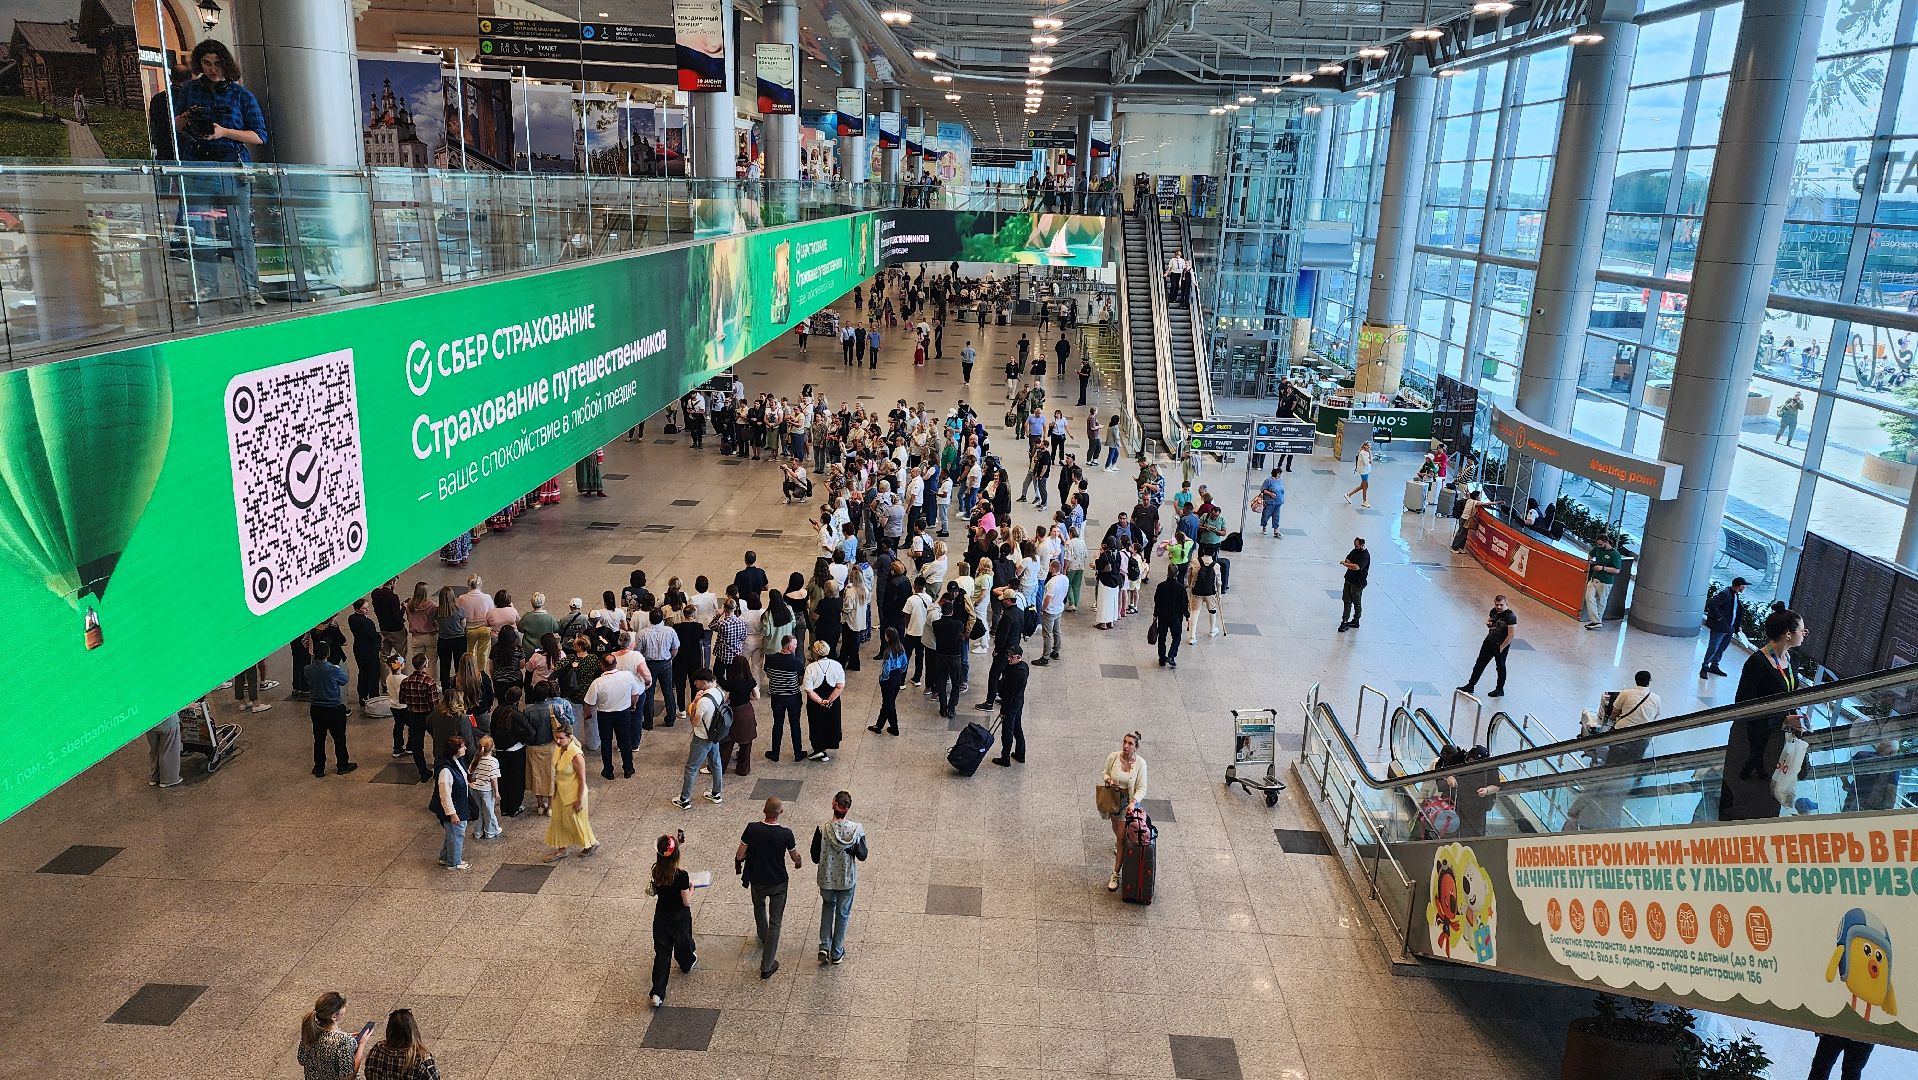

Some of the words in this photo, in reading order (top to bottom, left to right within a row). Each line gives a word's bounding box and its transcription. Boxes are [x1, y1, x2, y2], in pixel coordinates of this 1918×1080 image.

[437, 333, 489, 377] СБЕР
[491, 304, 596, 361] СТРАХОВАНИЕ
[412, 377, 549, 460] Страхование
[552, 329, 667, 403] путешественников
[438, 461, 478, 501] ваше
[481, 420, 561, 477] спокойствие
[562, 418, 570, 434] в
[571, 392, 603, 429] любой
[1588, 458, 1627, 482] Meeting
[1628, 471, 1658, 488] point
[60, 704, 140, 757] sberbankins.ru
[1515, 844, 1576, 868] ЛЮБИМЫЕ
[1577, 843, 1623, 866] ГЕРОИ
[1625, 835, 1769, 866] МИ-МИ-МИШЕК
[1770, 831, 1865, 864] ТЕПЕРЬ
[1868, 830, 1890, 863] В
[1515, 869, 1568, 889] НАЧНИТЕ
[1568, 868, 1674, 891] ПУТЕШЕСТВИЕ
[1676, 868, 1687, 891] С
[1550, 934, 1582, 946] Бесплатное
[1583, 939, 1627, 952] пространство
[1629, 944, 1642, 954] для
[1643, 946, 1689, 962] пассажиров
[1690, 952, 1696, 960] с
[1697, 951, 1729, 965] детьми
[1730, 951, 1747, 969] (до
[1748, 954, 1755, 968] 8
[1757, 956, 1778, 974] лет)
[1562, 947, 1590, 961] Терминал
[1597, 951, 1614, 965] Вход
[1622, 956, 1655, 972] ориентир
[1661, 960, 1688, 973] стойка
[1689, 965, 1745, 982] регистрации
[1746, 970, 1762, 985] 156
